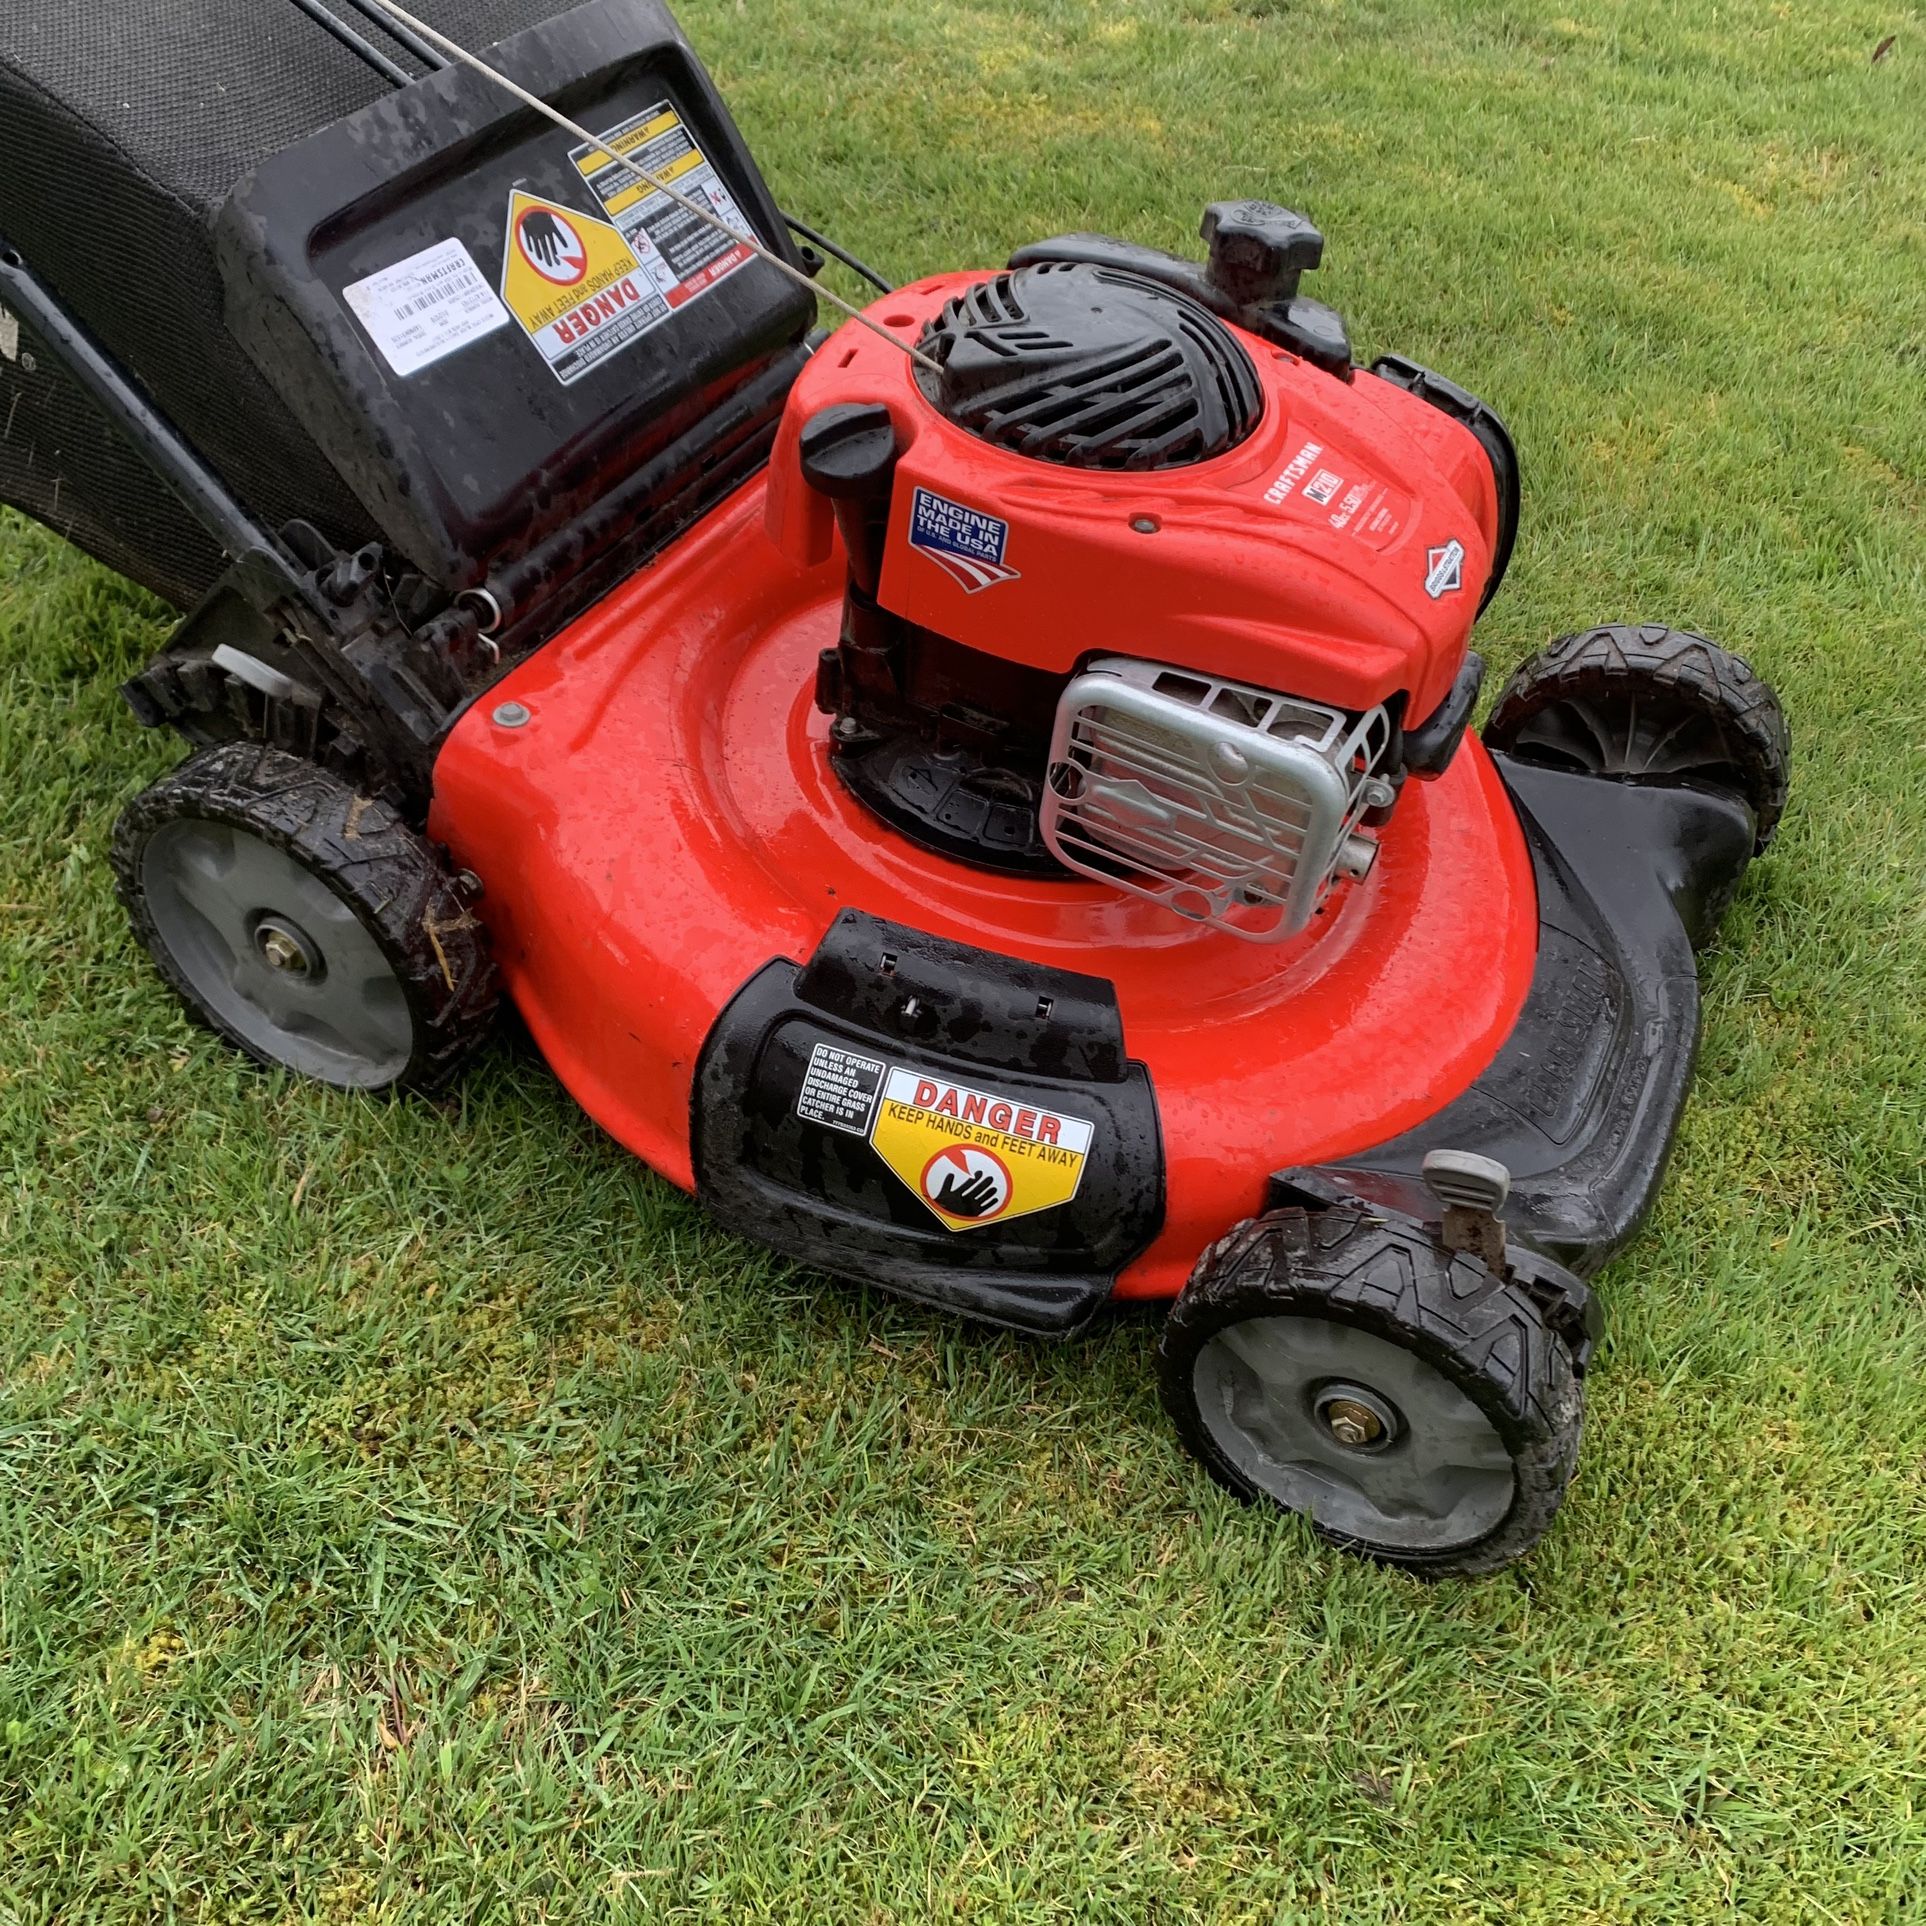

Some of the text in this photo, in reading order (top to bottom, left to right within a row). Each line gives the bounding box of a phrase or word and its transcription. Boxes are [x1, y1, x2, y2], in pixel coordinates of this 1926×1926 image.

[419, 257, 465, 285] CRAFTSMAN
[708, 252, 737, 277] DANGER
[526, 254, 632, 329] KEEP HANDS and FEET AWAY
[551, 276, 640, 346] DANGER
[1262, 440, 1323, 505] CRAFTSMAN
[1305, 470, 1339, 502] M210
[918, 506, 999, 546] MADE IN
[920, 493, 1001, 535] ENGINE
[917, 515, 998, 556] THE USA
[926, 530, 937, 539] U.S.
[938, 536, 951, 545] AND
[952, 542, 975, 554] GLOBAL
[976, 551, 997, 562] PARTS
[812, 1057, 856, 1076] UNLESS AN
[816, 1047, 880, 1073] DO NOT OPERATE
[807, 1077, 872, 1103] DISCHARGE COVER
[809, 1067, 859, 1088] UNDAMAGED
[799, 1105, 825, 1119] PLACE.
[801, 1096, 854, 1118] CATCHER IS IN
[804, 1086, 865, 1111] OR ENTIRE GRASS
[913, 1079, 1062, 1144] DANGER
[888, 1102, 923, 1129] KEEP
[926, 1115, 973, 1140] HANDS
[974, 1131, 998, 1147] and
[1001, 1136, 1036, 1158] FEET
[1038, 1143, 1078, 1168] AWAY
